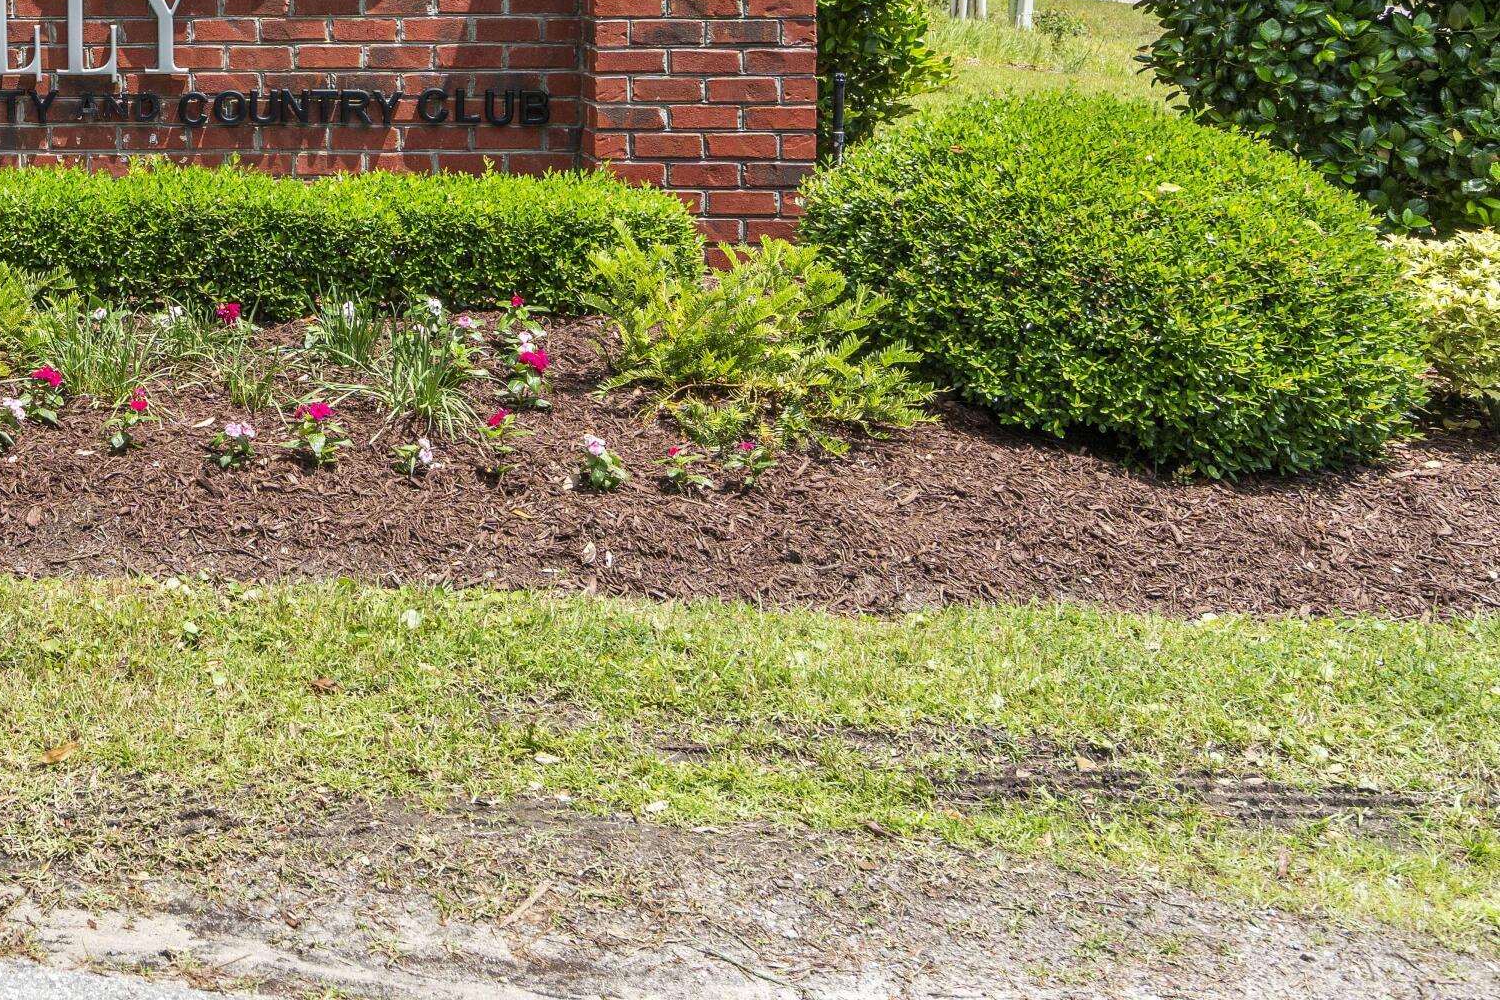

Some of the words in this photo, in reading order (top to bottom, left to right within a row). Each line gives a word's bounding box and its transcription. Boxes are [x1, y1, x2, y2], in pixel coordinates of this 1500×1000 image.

[75, 91, 160, 122] AND
[178, 88, 402, 126] COUNTRY
[418, 87, 550, 126] CLUB
